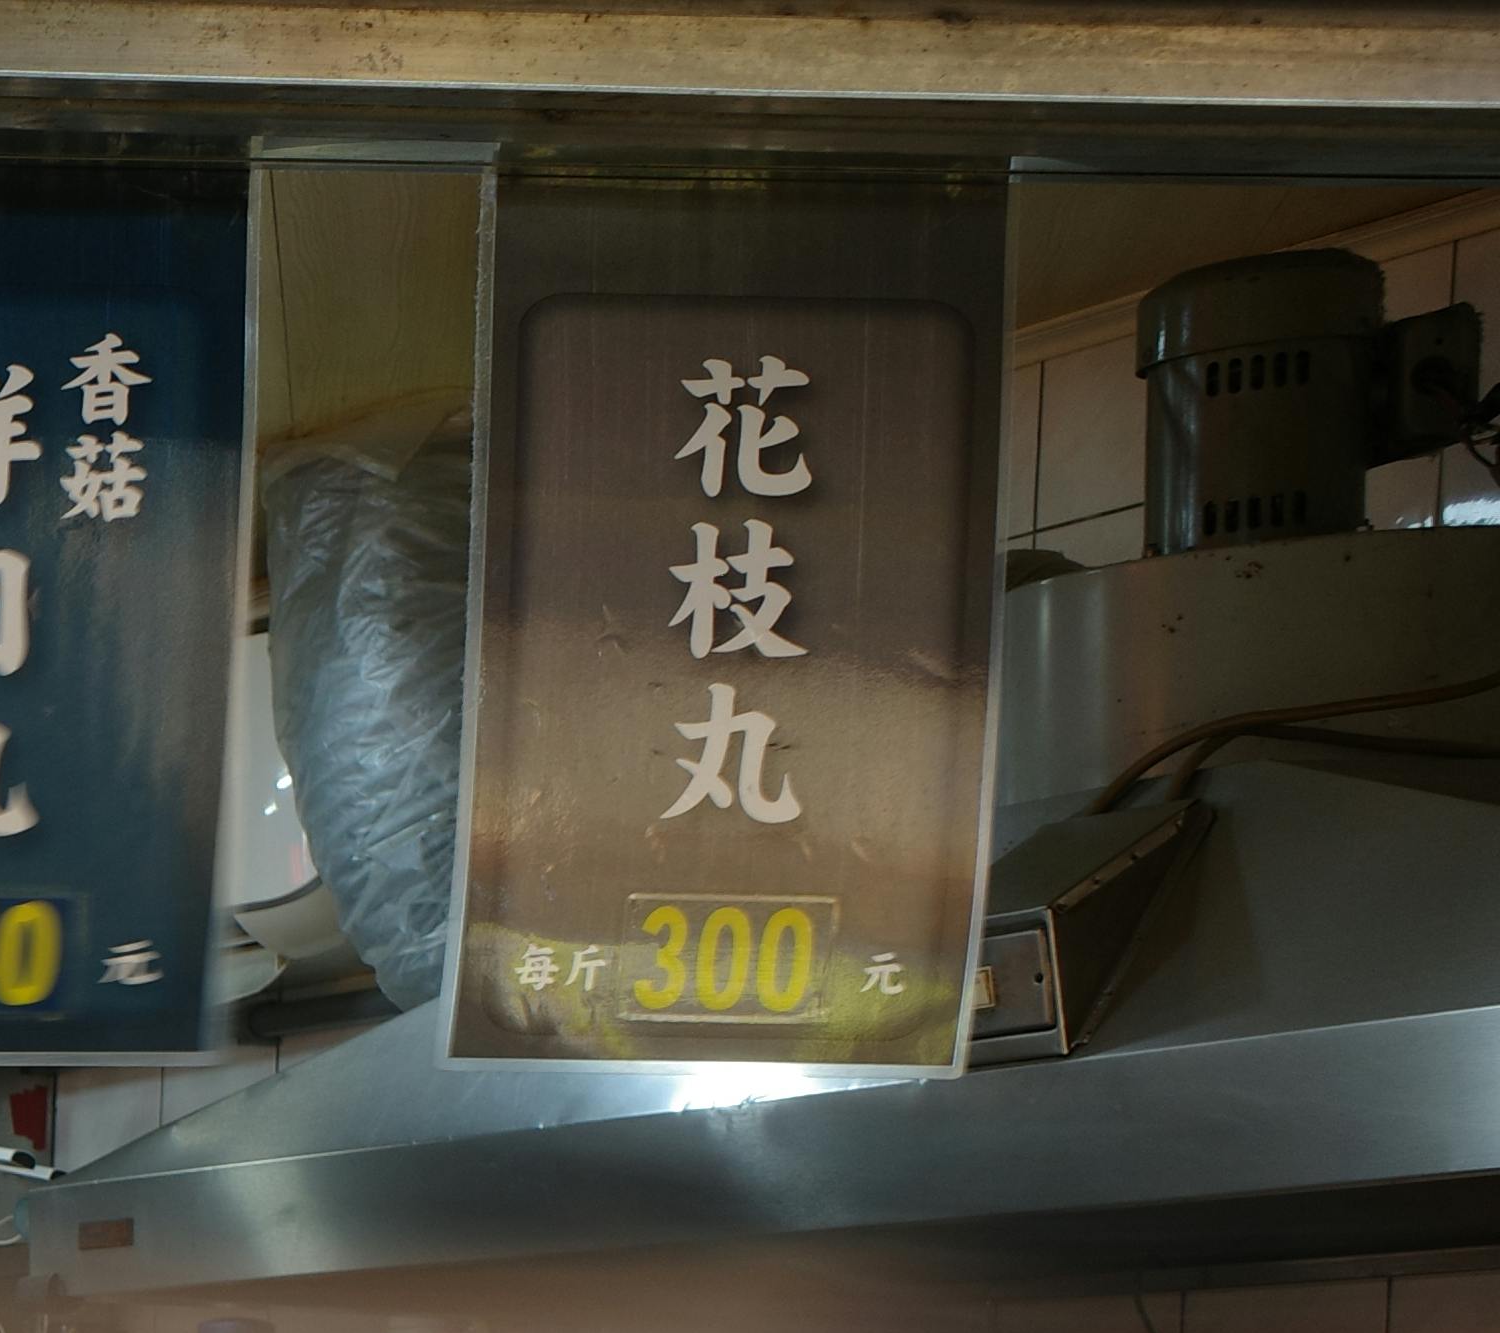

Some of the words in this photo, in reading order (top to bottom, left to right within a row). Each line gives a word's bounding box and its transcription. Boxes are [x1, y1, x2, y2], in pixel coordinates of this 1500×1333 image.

[59, 332, 152, 522] 香菇
[660, 355, 813, 824] 花枝丸
[99, 940, 165, 985] 元
[514, 943, 609, 993] 每斤
[632, 904, 812, 1013] 300
[860, 951, 907, 998] 元
